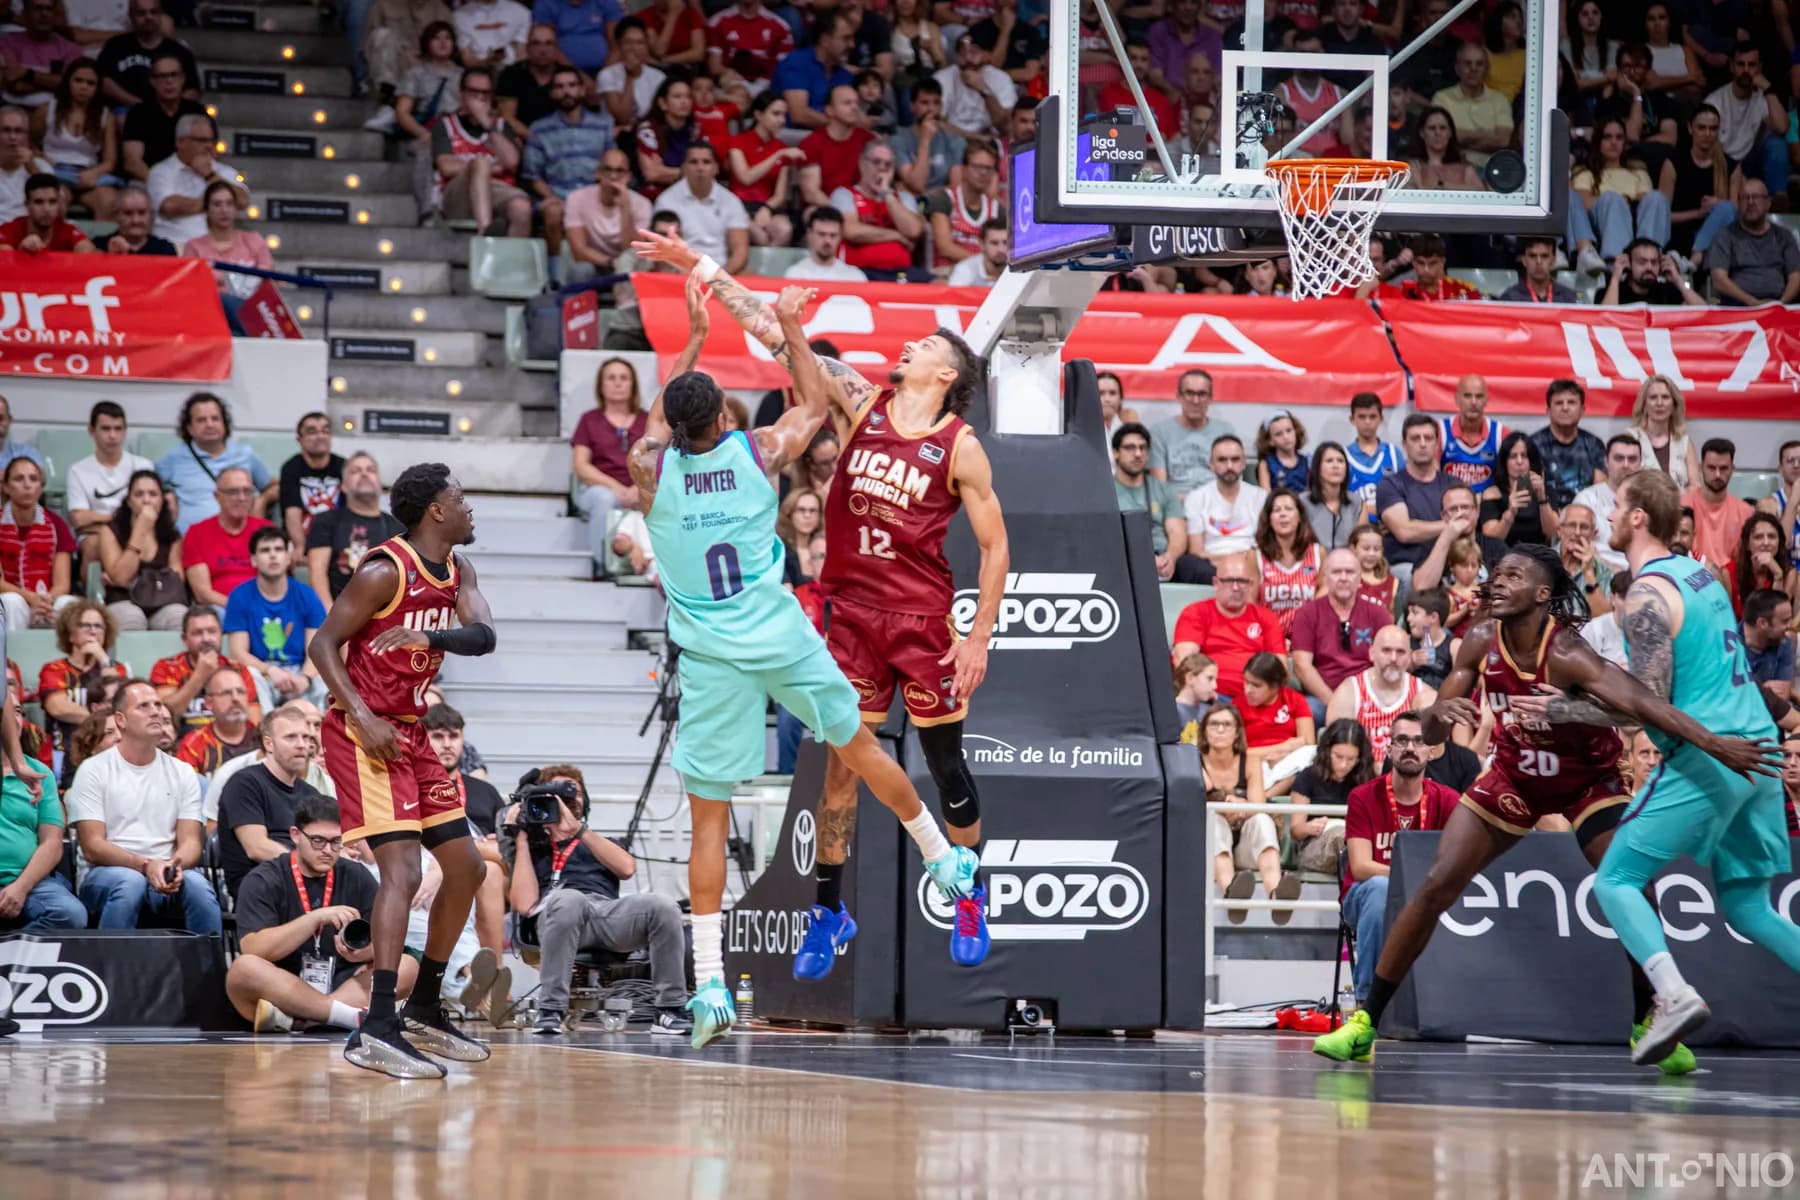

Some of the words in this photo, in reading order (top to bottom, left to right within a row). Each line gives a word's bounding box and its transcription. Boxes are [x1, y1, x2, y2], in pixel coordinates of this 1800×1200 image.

[1092, 135, 1116, 149] liga
[1092, 150, 1144, 160] endesa
[683, 468, 737, 496] PUNTER
[847, 448, 932, 503] UCAM
[1453, 462, 1485, 474] UCAM
[850, 476, 910, 511] MURCIA
[858, 525, 897, 561] 12
[704, 541, 744, 602] 0
[1264, 584, 1316, 602] UCAM
[974, 746, 1014, 763] más
[1020, 746, 1043, 763] de
[1049, 747, 1067, 763] la
[1071, 747, 1142, 768] familia
[1518, 749, 1560, 777] 20
[728, 909, 762, 953] LET'S
[764, 910, 788, 955] GO
